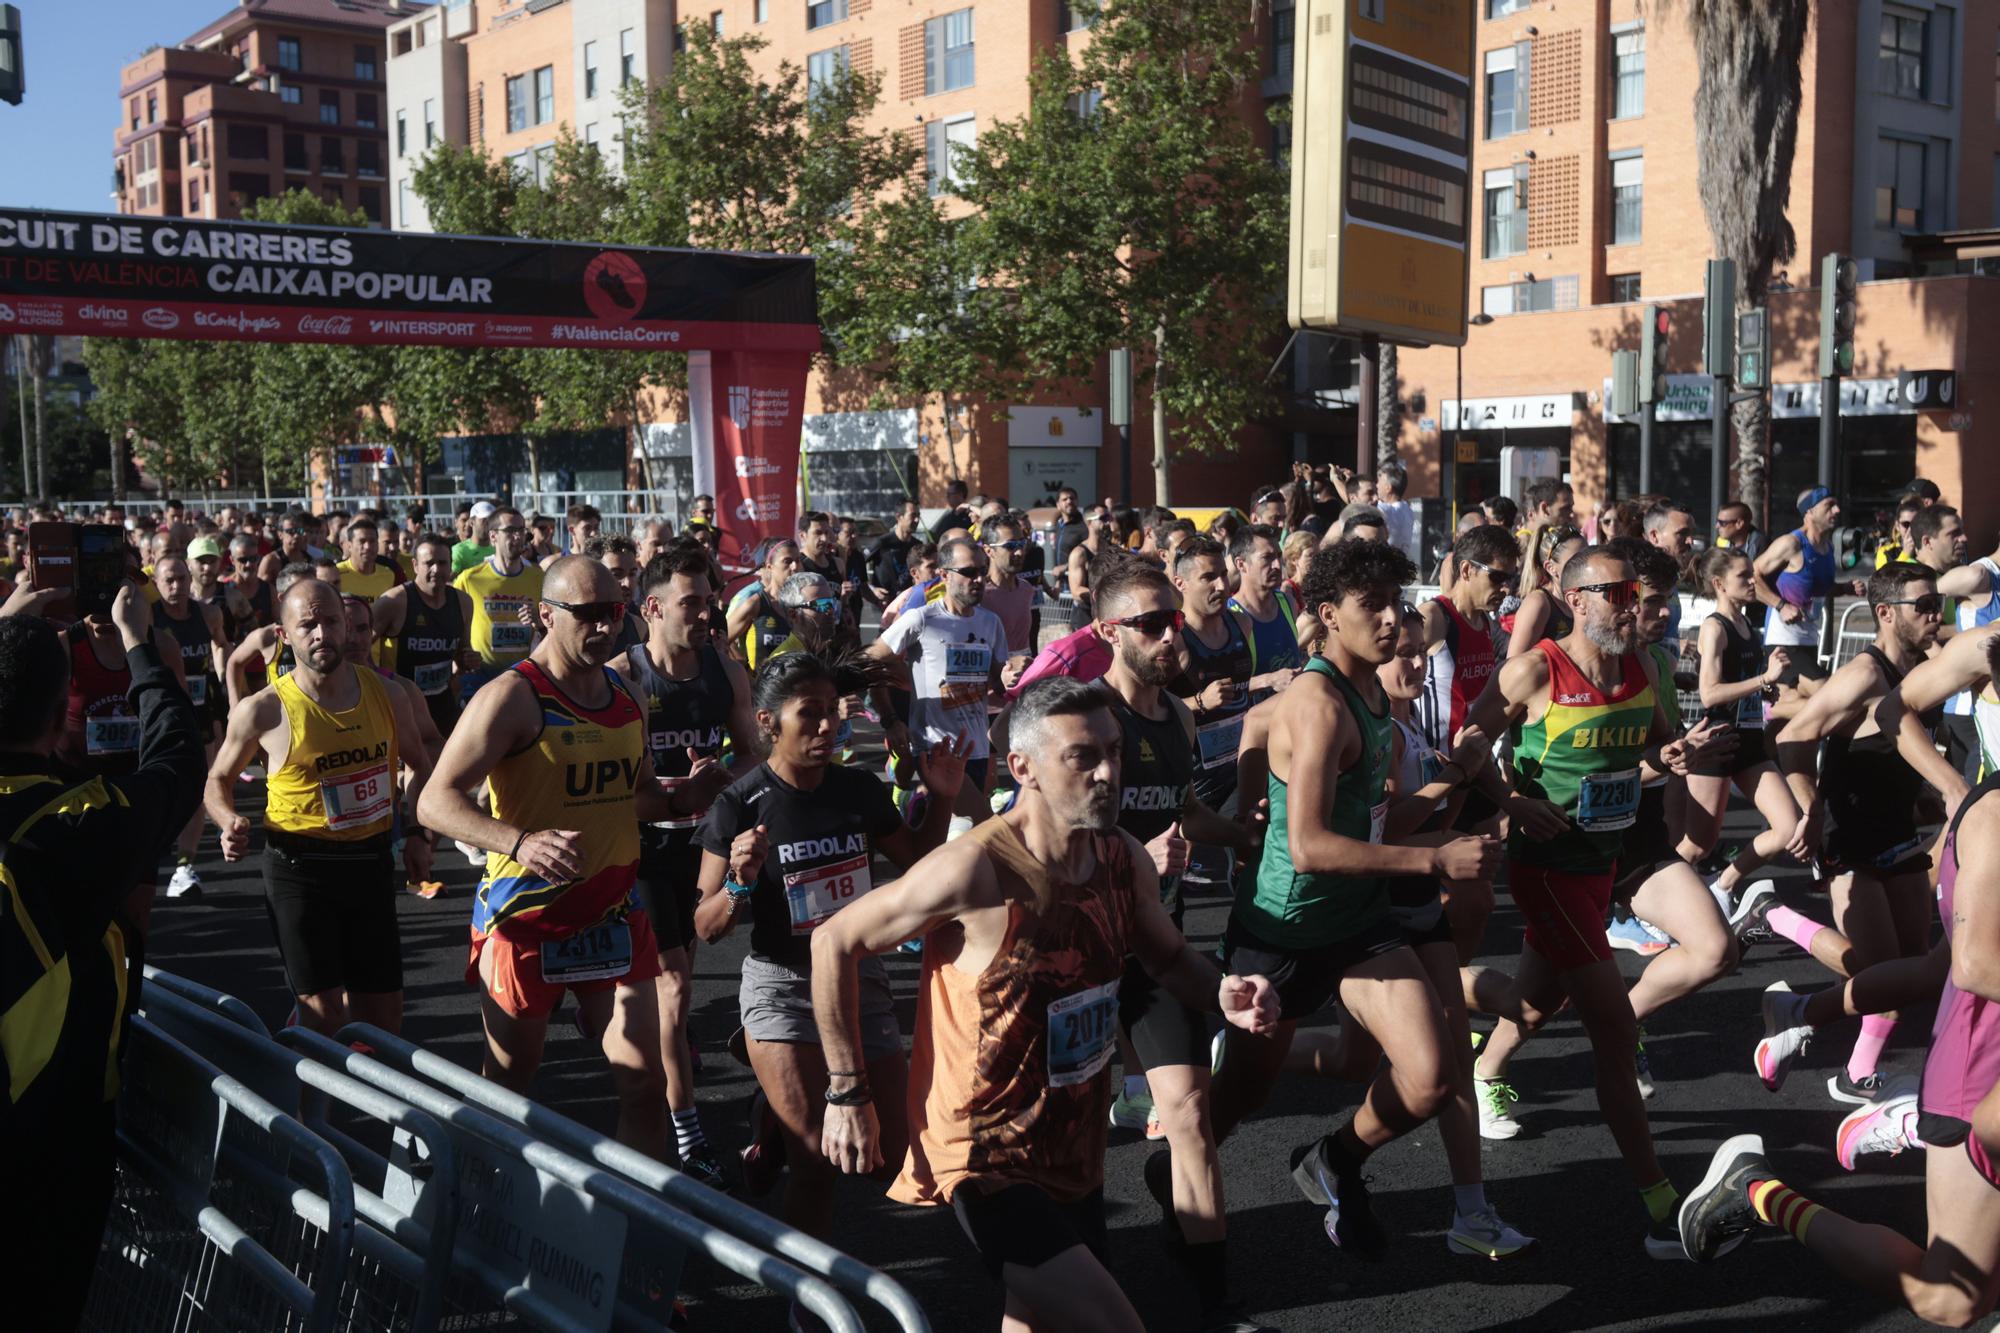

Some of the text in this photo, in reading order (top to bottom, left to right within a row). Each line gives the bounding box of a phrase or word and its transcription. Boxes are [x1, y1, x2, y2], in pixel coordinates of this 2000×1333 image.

[91, 224, 144, 254] DE
[151, 227, 353, 266] CARRERES
[23, 257, 62, 284] DE
[68, 258, 200, 289] VALÈNCIA
[79, 304, 128, 320] divina
[384, 321, 476, 337] INTERSPORT
[551, 324, 680, 343] #ValènciaCorre
[1665, 383, 1710, 399] Urban
[408, 637, 460, 651] REDOLA
[496, 628, 525, 641] 2455
[953, 651, 983, 667] 2401
[95, 723, 140, 744] 2097
[650, 728, 720, 751] EDOLA
[566, 757, 641, 797] UPV
[354, 779, 378, 802] 68
[1589, 782, 1634, 808] 2230
[778, 834, 863, 864] REDOLAT
[824, 876, 855, 901] 18
[528, 1237, 604, 1309] RUNNING
